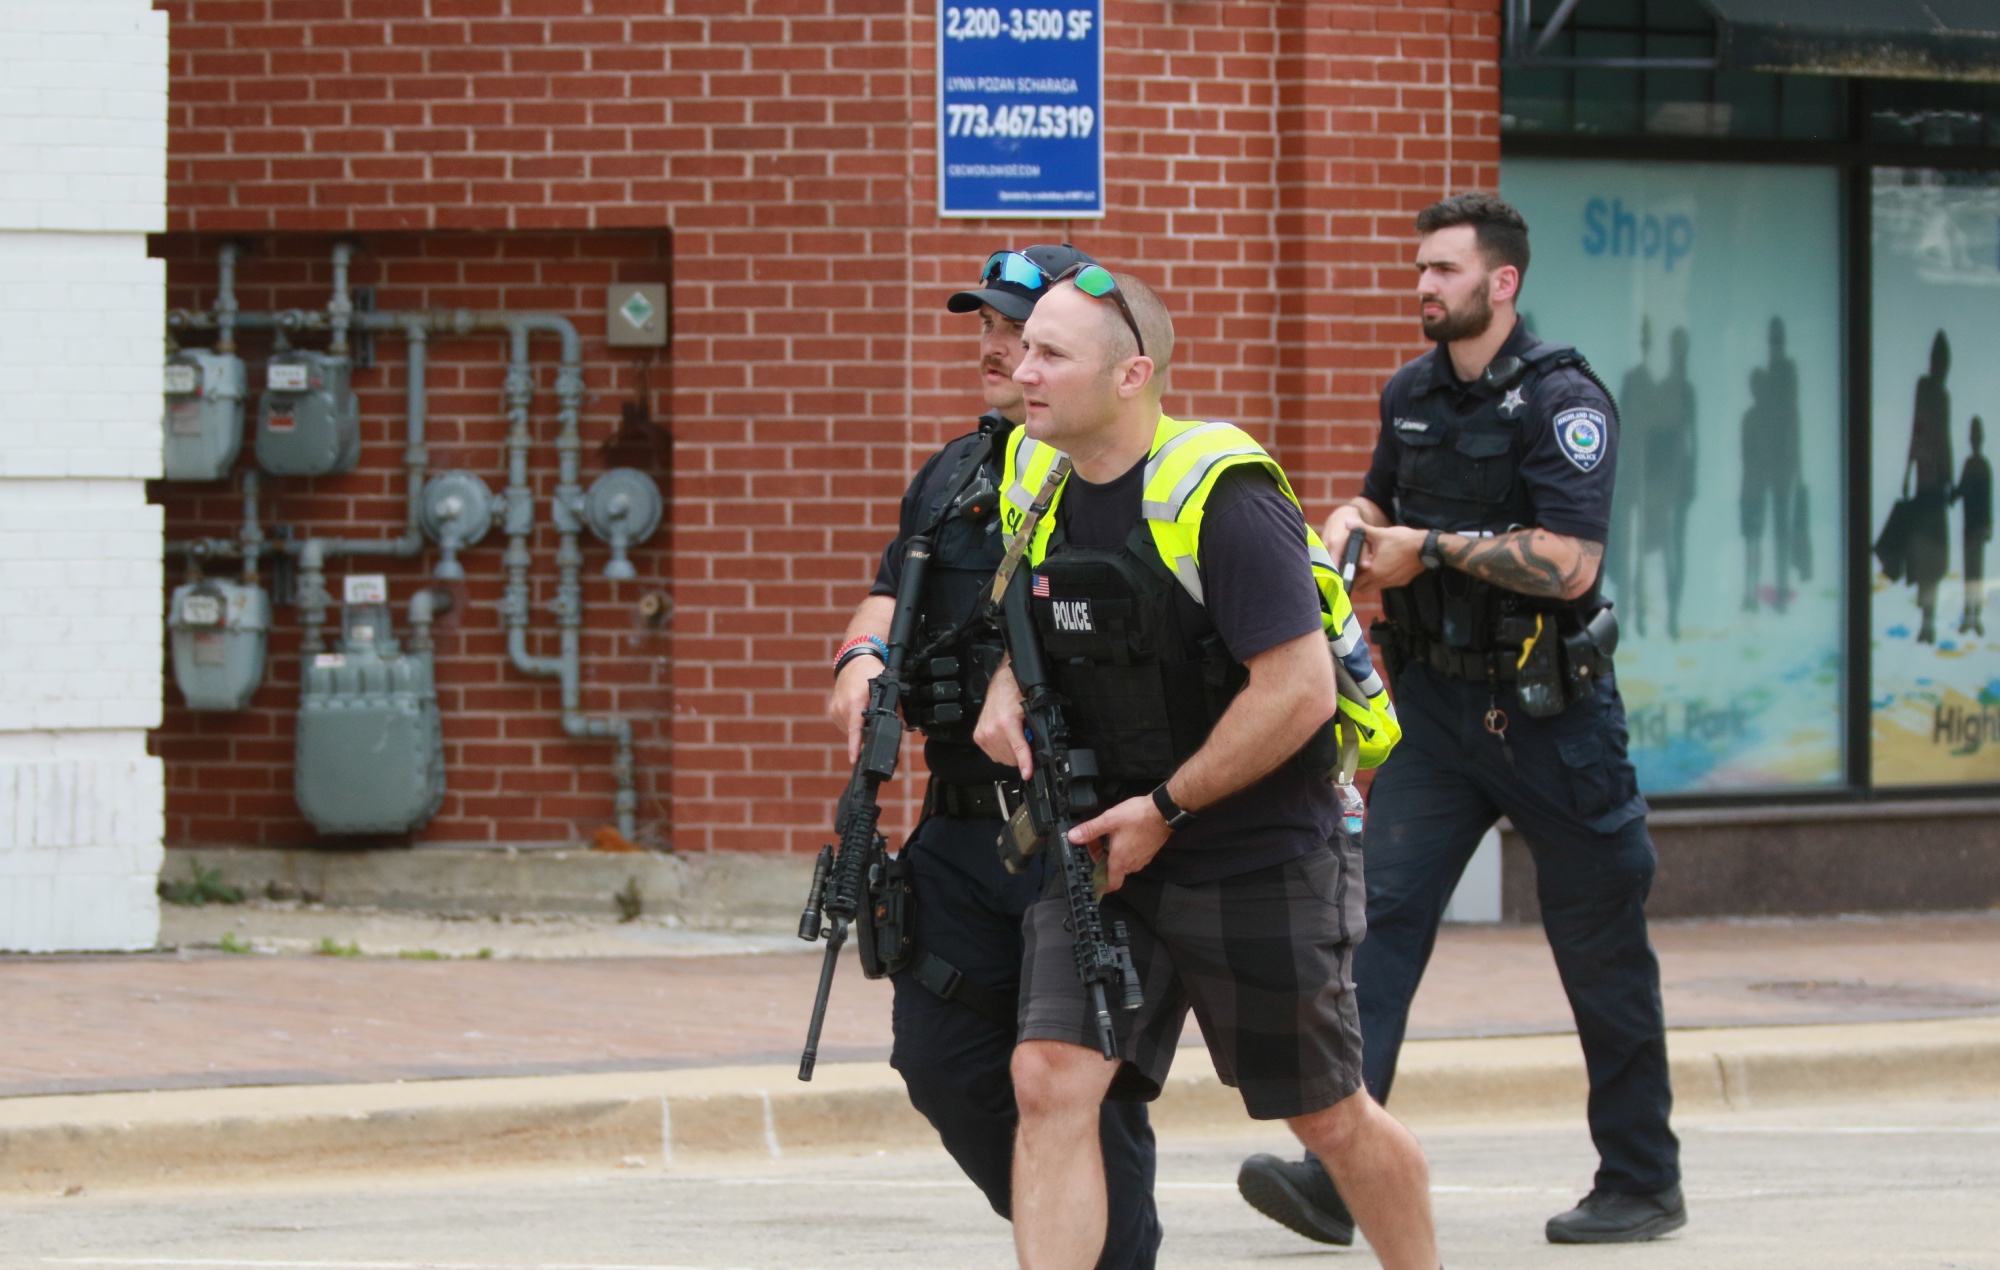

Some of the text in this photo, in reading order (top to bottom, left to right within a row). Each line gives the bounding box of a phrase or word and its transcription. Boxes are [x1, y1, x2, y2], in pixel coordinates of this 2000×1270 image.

[1066, 9, 1093, 40] SF
[947, 76, 976, 92] LYNN
[1017, 77, 1079, 94] SCHARAGA
[946, 104, 1095, 138] 773.467.5319
[1583, 196, 1693, 273] Shop
[1558, 412, 1588, 425] HIGHLAND
[1052, 601, 1093, 631] POLICE
